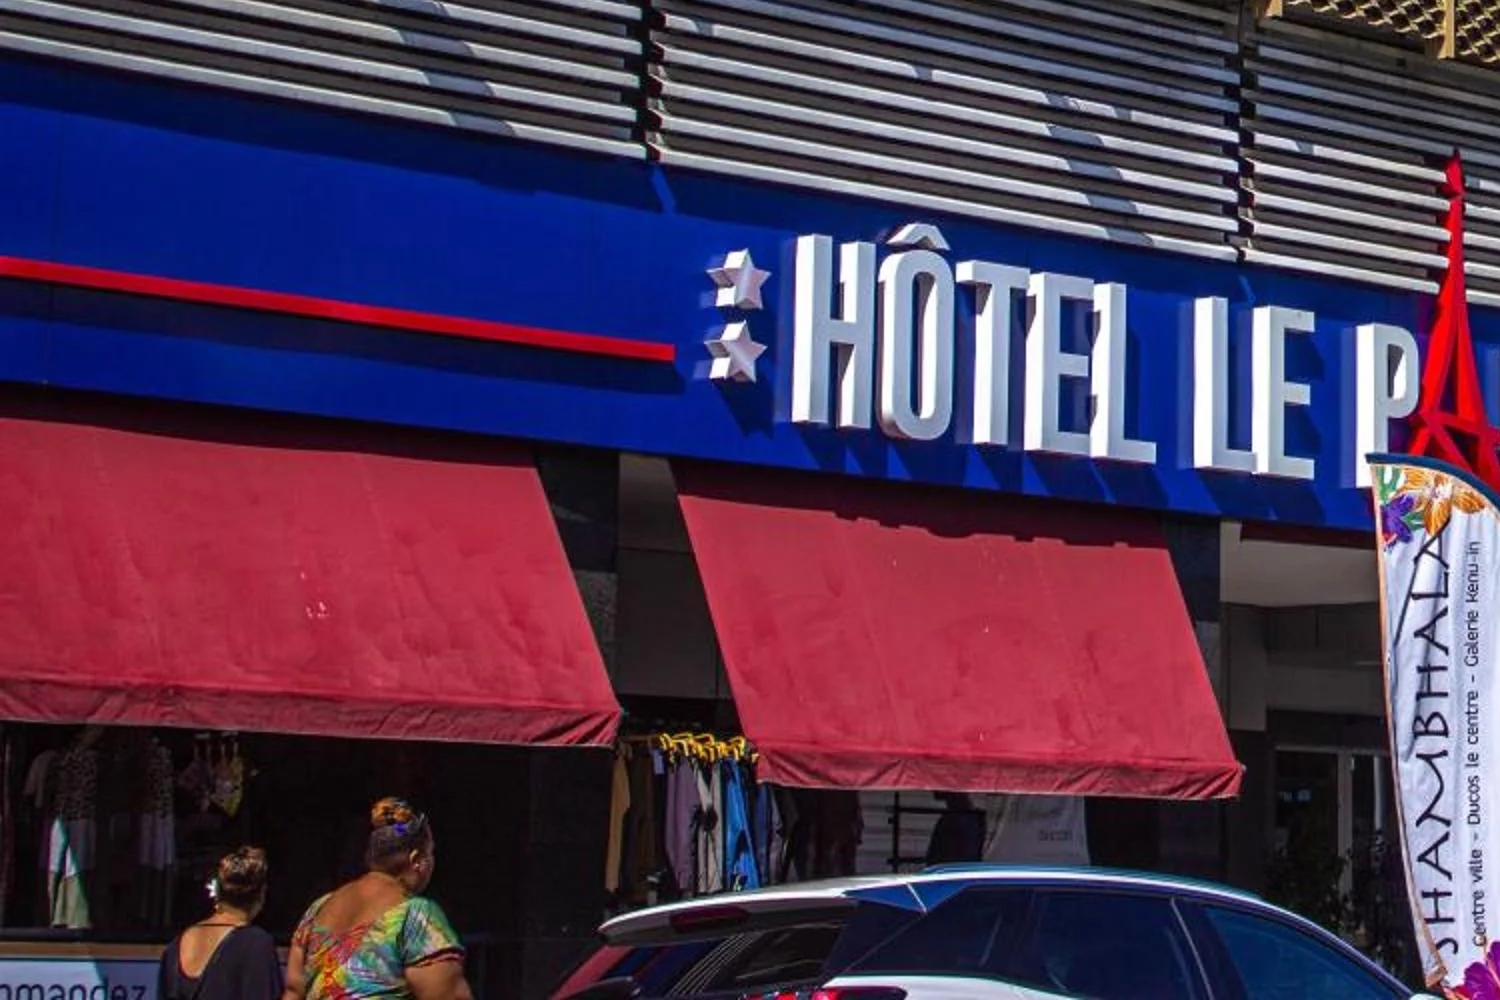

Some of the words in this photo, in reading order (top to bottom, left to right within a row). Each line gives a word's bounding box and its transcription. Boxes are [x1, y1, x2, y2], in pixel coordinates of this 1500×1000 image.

[792, 223, 1156, 465] HÔTEL
[1192, 296, 1315, 479] LE
[1464, 609, 1479, 667] Galerie
[1465, 691, 1479, 744] centre
[1465, 753, 1479, 768] le
[1467, 775, 1481, 825] Ducos
[1469, 849, 1484, 883] ville
[1472, 890, 1488, 947] Centre
